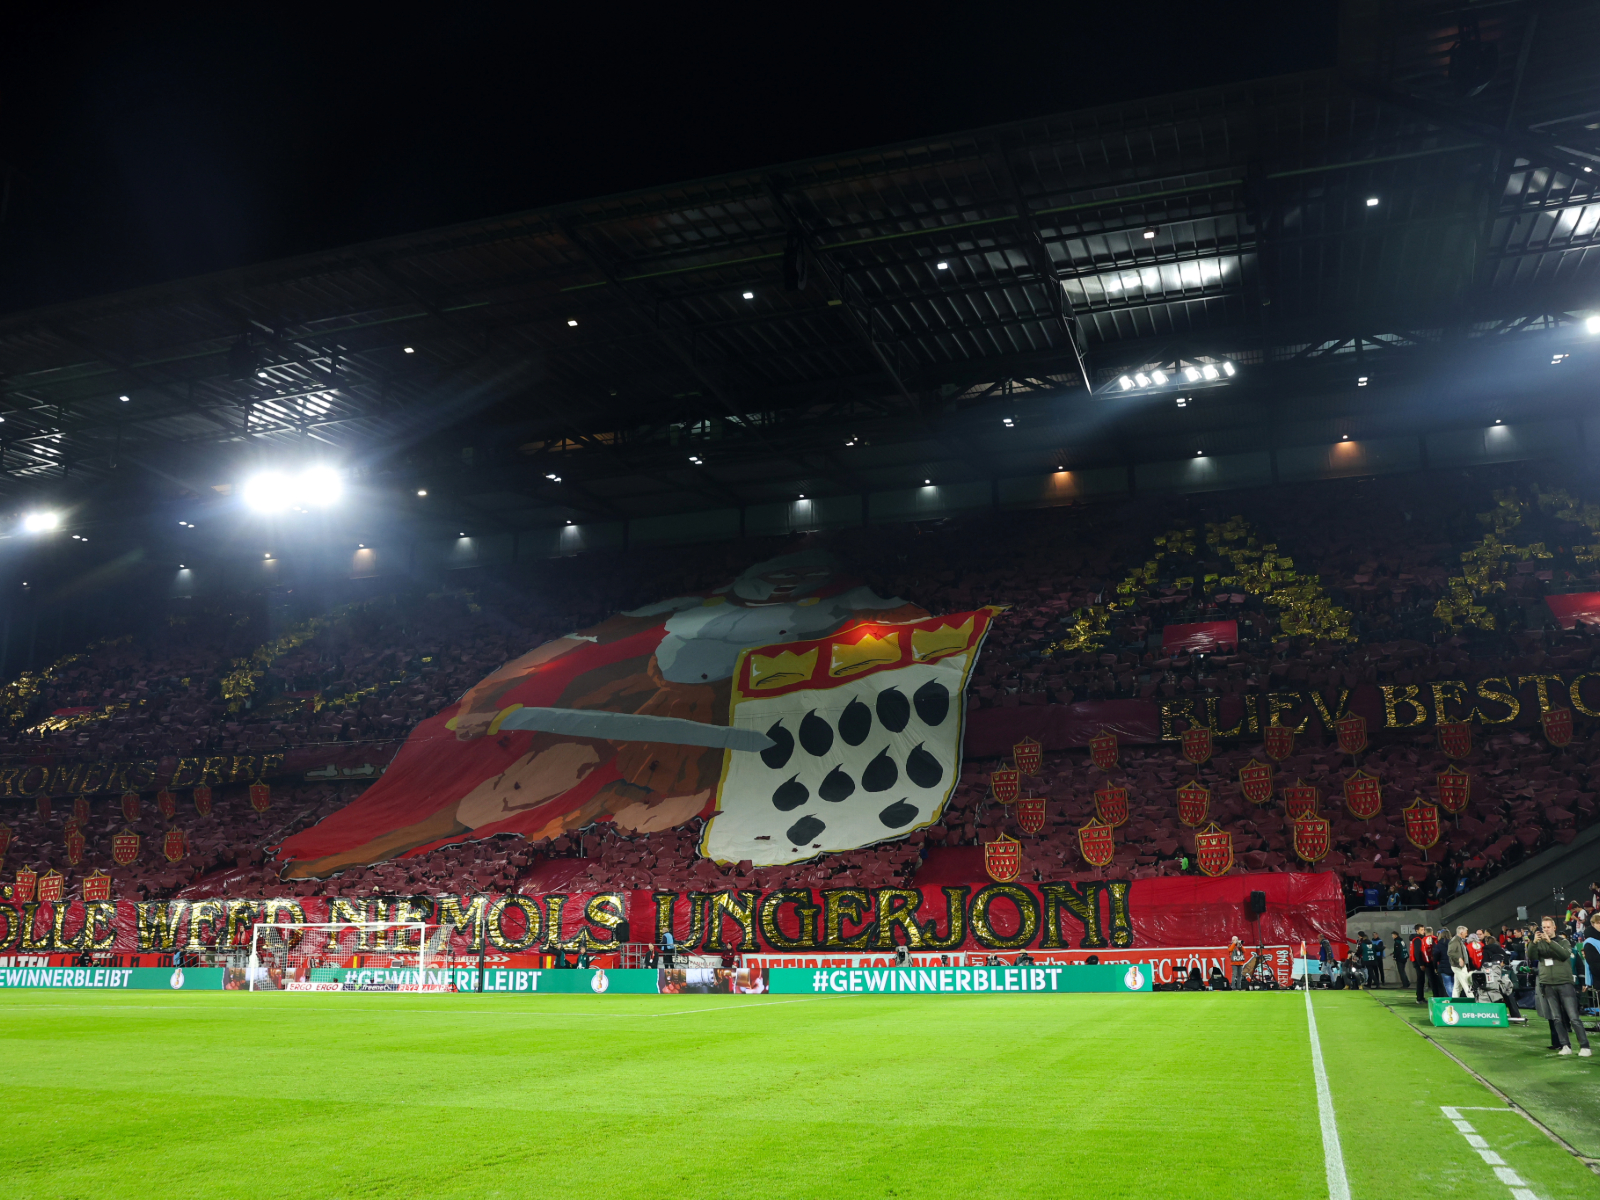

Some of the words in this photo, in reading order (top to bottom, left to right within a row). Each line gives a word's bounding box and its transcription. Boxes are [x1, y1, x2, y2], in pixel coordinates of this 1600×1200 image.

[652, 882, 1134, 954] UNGERJON!
[1276, 950, 1289, 966] 1948
[290, 983, 312, 991] ERGO
[316, 983, 339, 991] ERGO
[812, 968, 1062, 992] #GEWINNERBLEIBT
